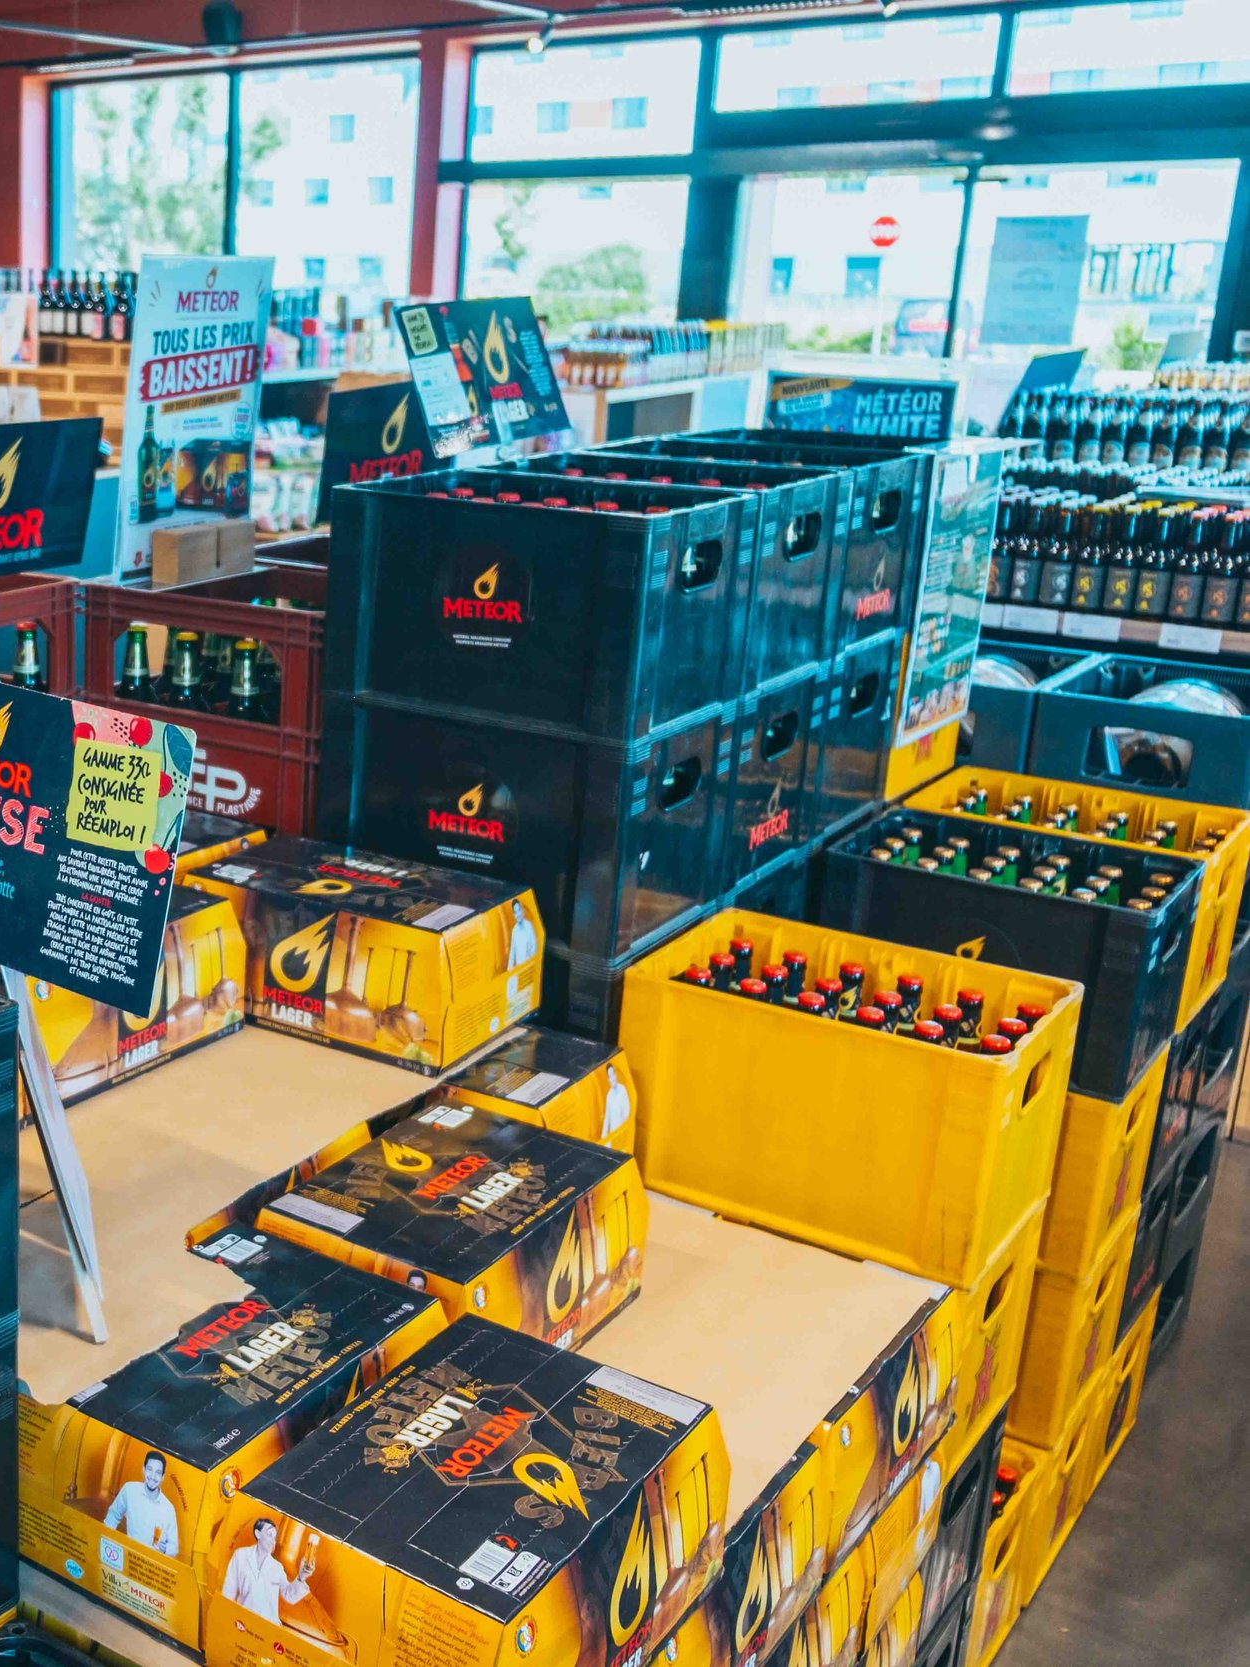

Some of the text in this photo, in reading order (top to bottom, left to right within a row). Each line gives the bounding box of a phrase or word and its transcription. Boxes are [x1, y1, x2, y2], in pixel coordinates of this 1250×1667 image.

[176, 290, 239, 313] METEOR
[153, 321, 254, 356] TOUS LES PRIX
[489, 382, 523, 401] METEOR
[855, 388, 943, 415] MÉTÉOR
[853, 414, 942, 438] WHITE
[349, 448, 422, 484] METEOR
[443, 596, 522, 623] METEOR
[855, 588, 891, 621] METEOR
[82, 746, 125, 772] GAMME
[77, 773, 145, 804] CONSIGNÉE
[216, 786, 261, 816] PLASTIQUE
[84, 796, 107, 815] POUR
[76, 811, 146, 845] RÉEMPLOI !
[428, 808, 504, 843] METEOR
[749, 808, 789, 851] METEOR
[57, 854, 67, 862] AUX
[67, 857, 87, 870] SAVEURS
[117, 872, 131, 884] NOUS
[131, 877, 148, 889] AVONS
[70, 848, 82, 858] POUR
[82, 852, 97, 863] CETTE
[97, 856, 117, 869] RECETTE
[89, 873, 100, 883] UNE
[127, 885, 144, 898] CERISE
[102, 886, 114, 898] BIEN
[47, 900, 61, 911] FRUIT
[61, 904, 79, 918] SOMBRE
[123, 915, 139, 927] PETIT
[71, 917, 86, 930] CETTE
[130, 937, 139, 947] ET
[263, 986, 325, 1015] METEOR
[271, 1003, 313, 1028] LAGER
[118, 1021, 167, 1054] METEOR
[125, 1040, 159, 1068] LAGER
[414, 1155, 492, 1200] METEOR
[460, 1171, 525, 1211] LAGER
[175, 1299, 271, 1359] METEOR
[225, 1321, 305, 1372] LAGER
[394, 1394, 475, 1448] LAGER
[434, 1406, 532, 1479] METEOR
[101, 1567, 122, 1588] Villa
[130, 1586, 166, 1610] METEOR
